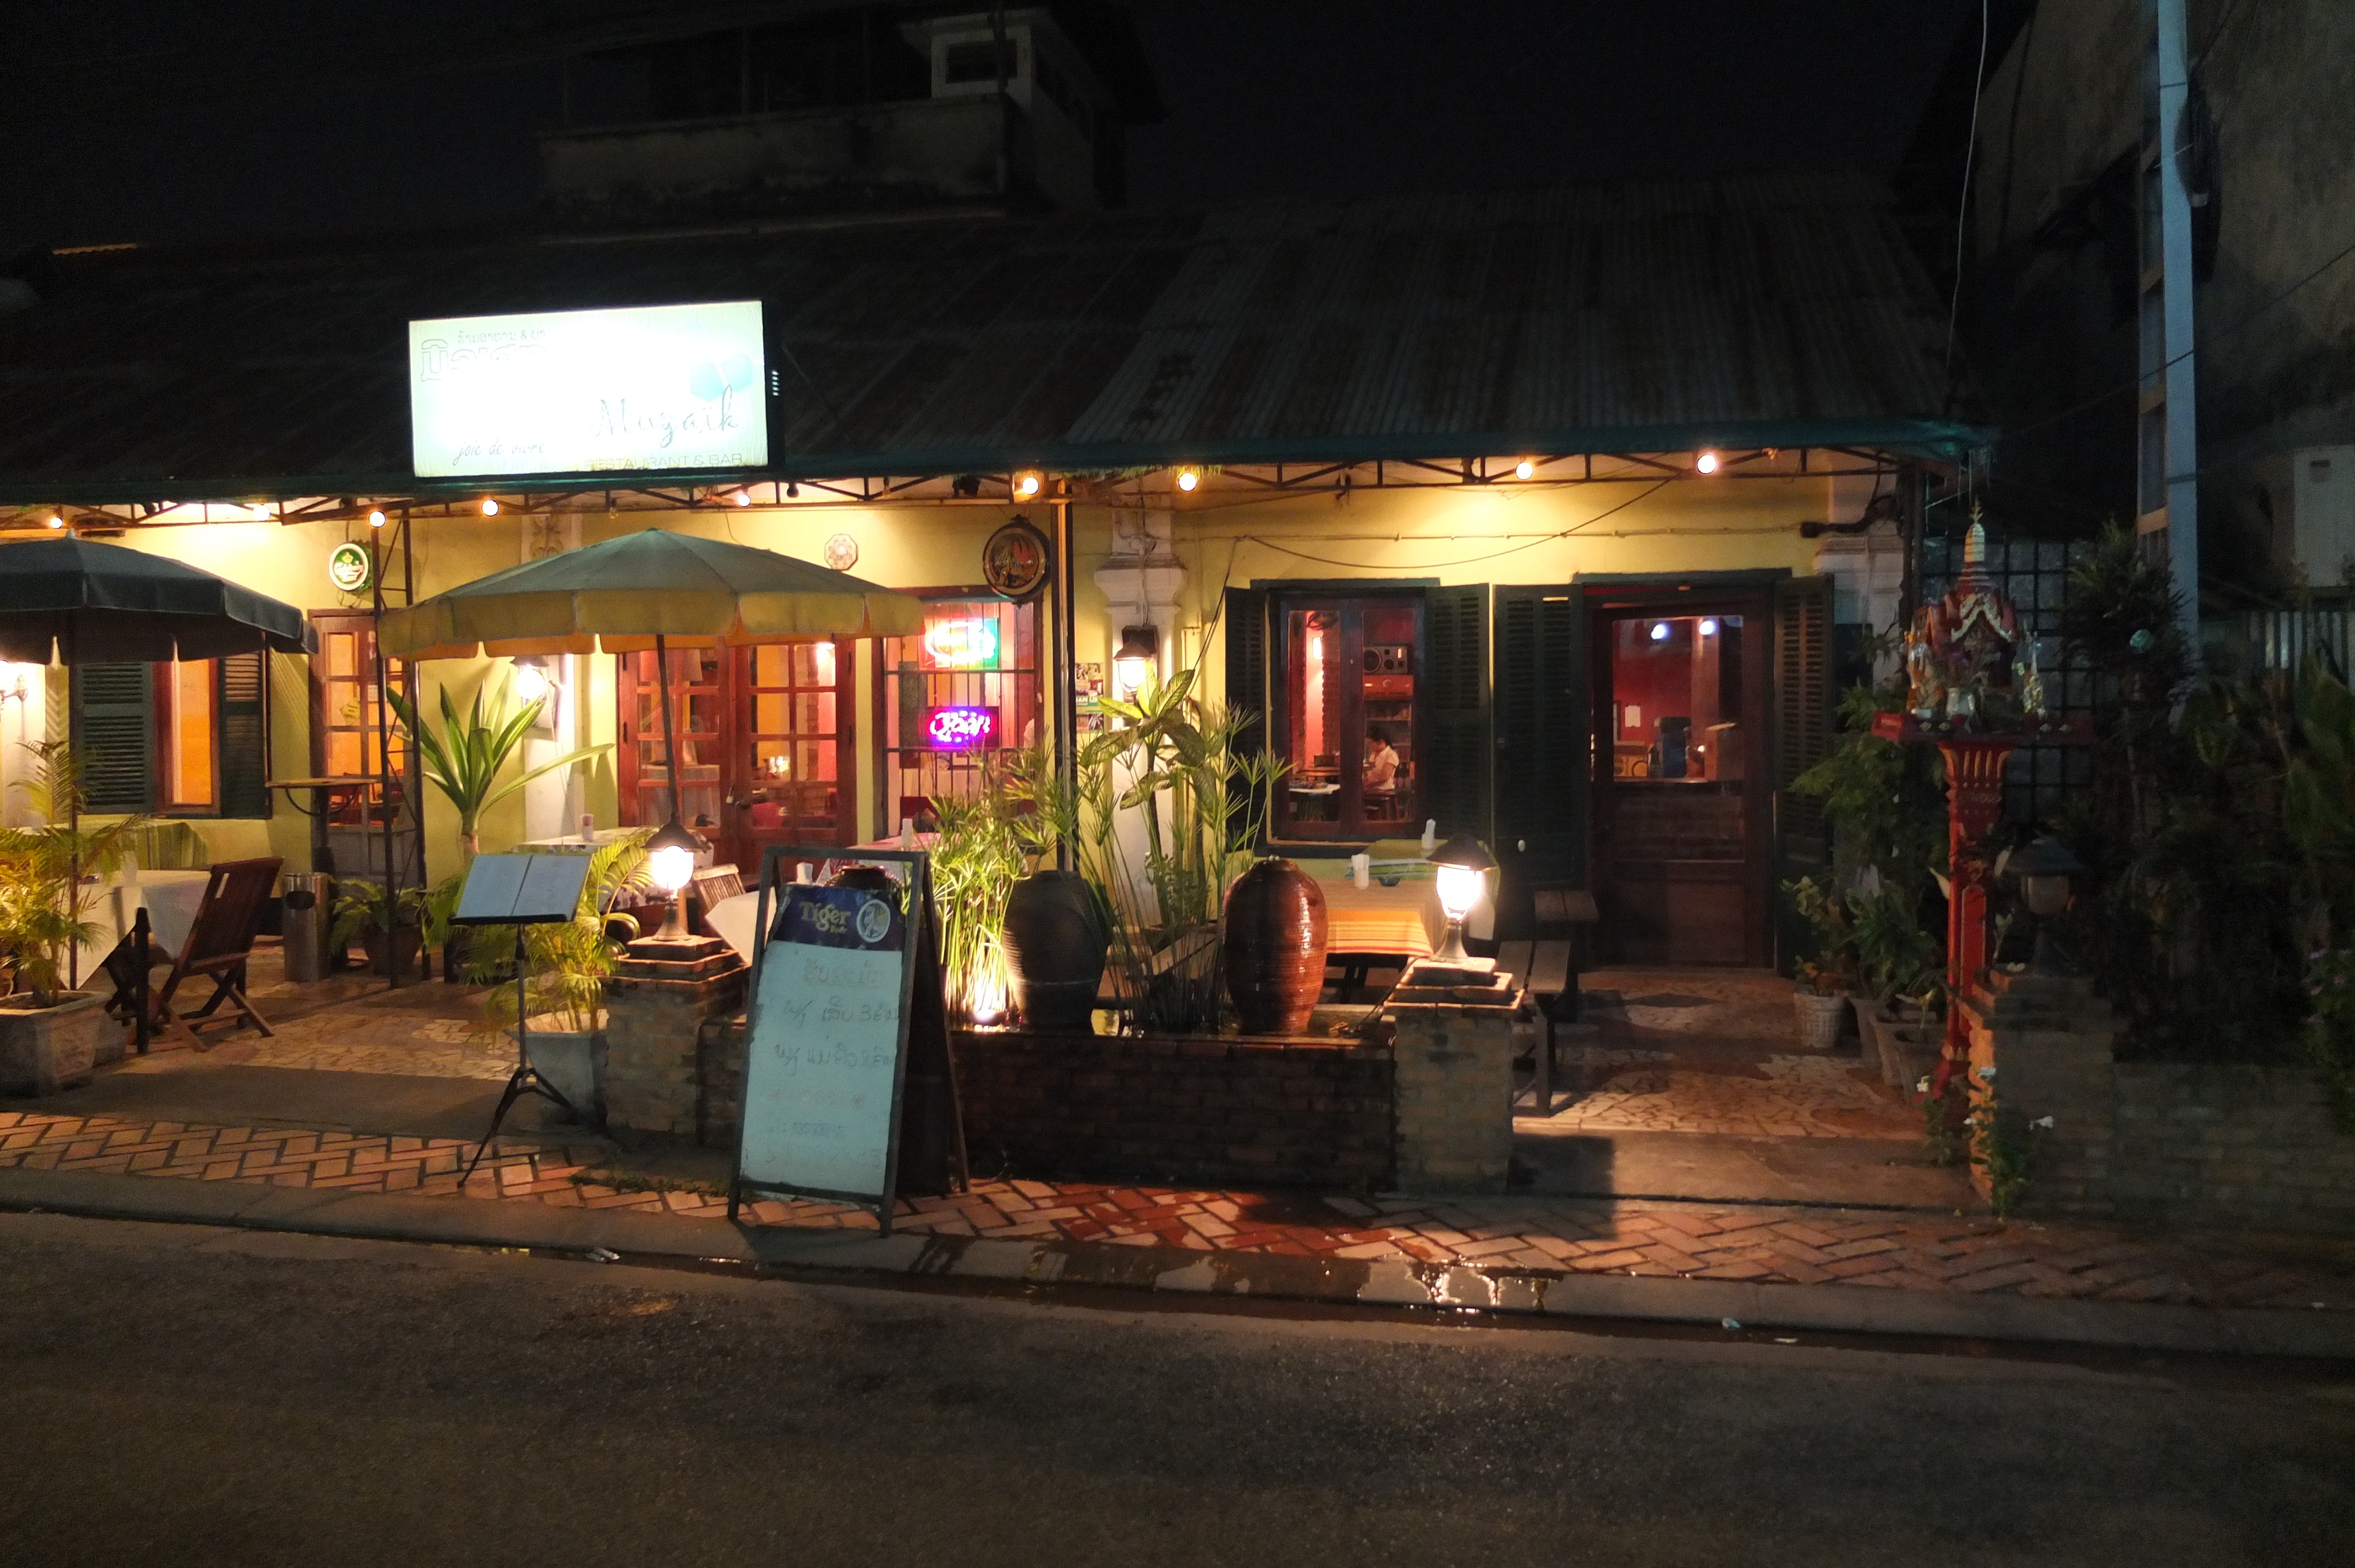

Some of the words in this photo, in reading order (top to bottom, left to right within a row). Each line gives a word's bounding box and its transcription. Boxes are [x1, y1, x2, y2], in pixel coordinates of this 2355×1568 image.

[520, 330, 527, 340] &
[584, 456, 689, 471] RESTAURANT
[694, 455, 704, 465] &
[709, 453, 742, 466] BAR
[799, 901, 851, 931] Tiger
